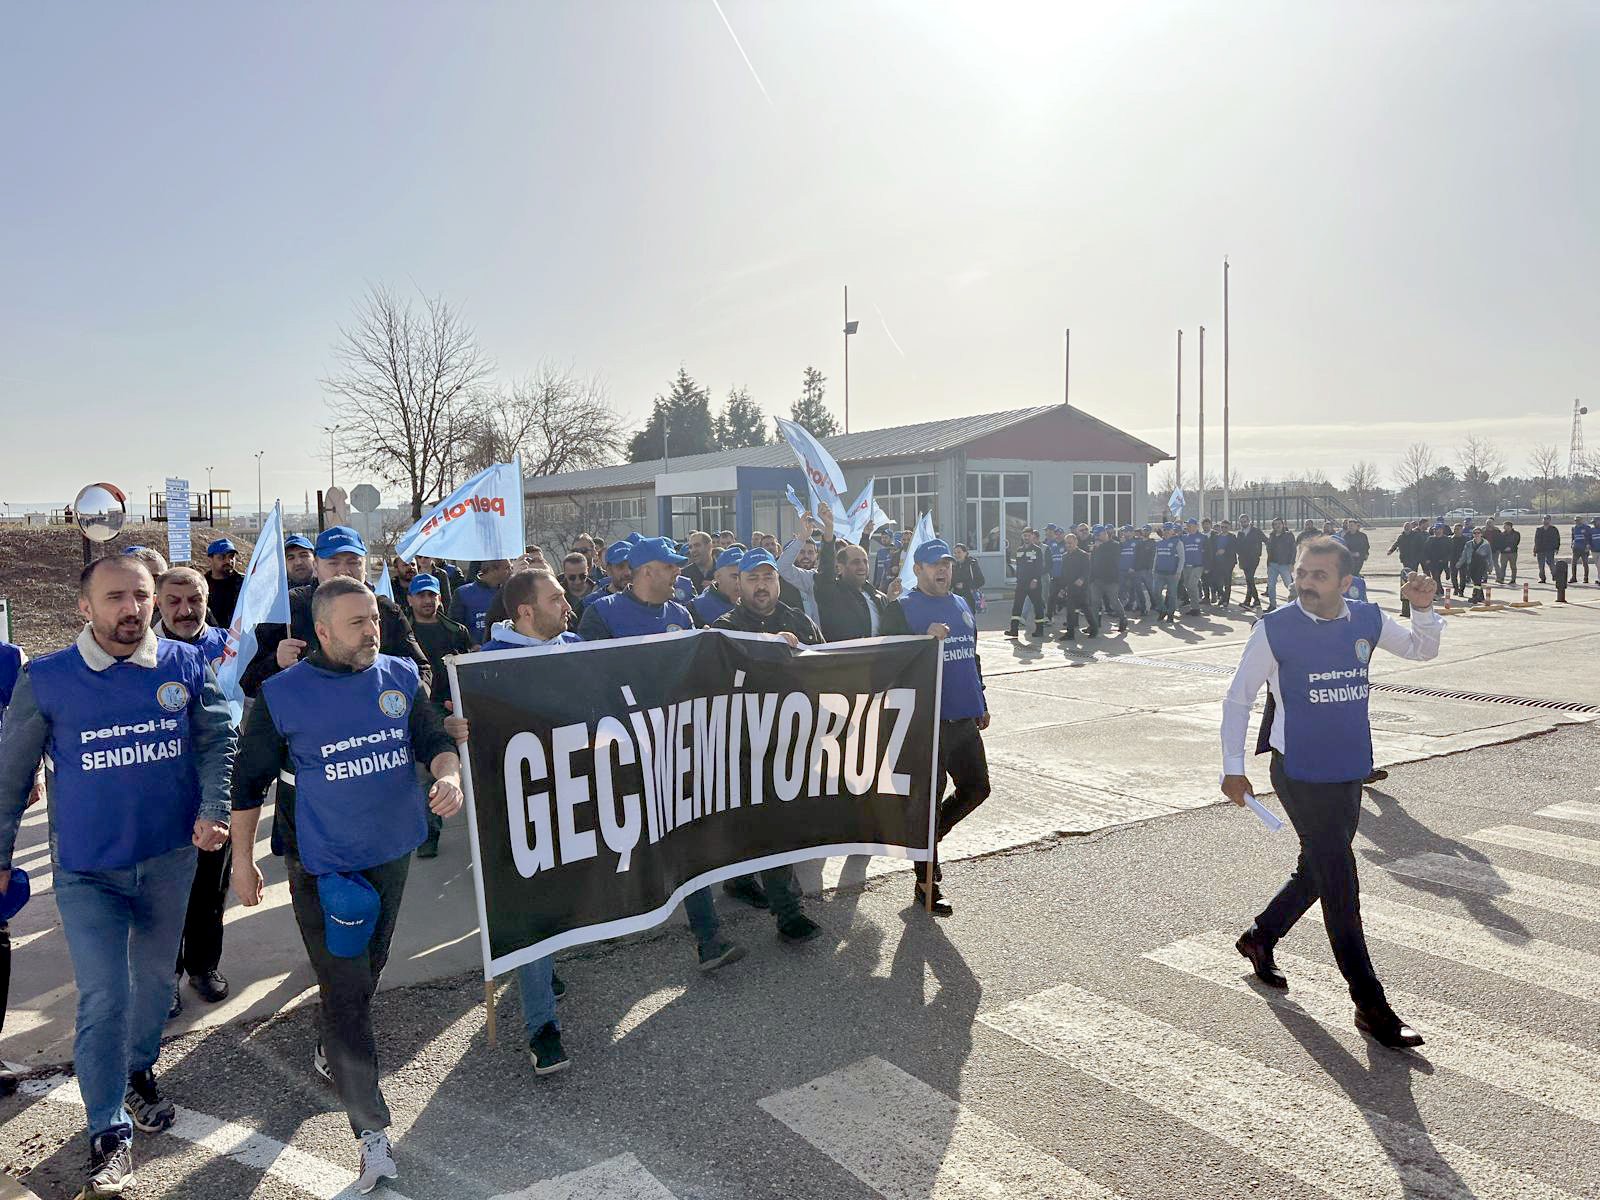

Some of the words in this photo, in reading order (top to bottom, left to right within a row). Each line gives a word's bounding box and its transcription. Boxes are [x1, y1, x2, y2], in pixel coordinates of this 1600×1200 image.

[80, 718, 178, 744] petrol-iş
[320, 727, 404, 758] petrol-iş
[81, 738, 182, 771] SENDİKASI
[504, 669, 916, 879] GEÇİNEMİYORUZ
